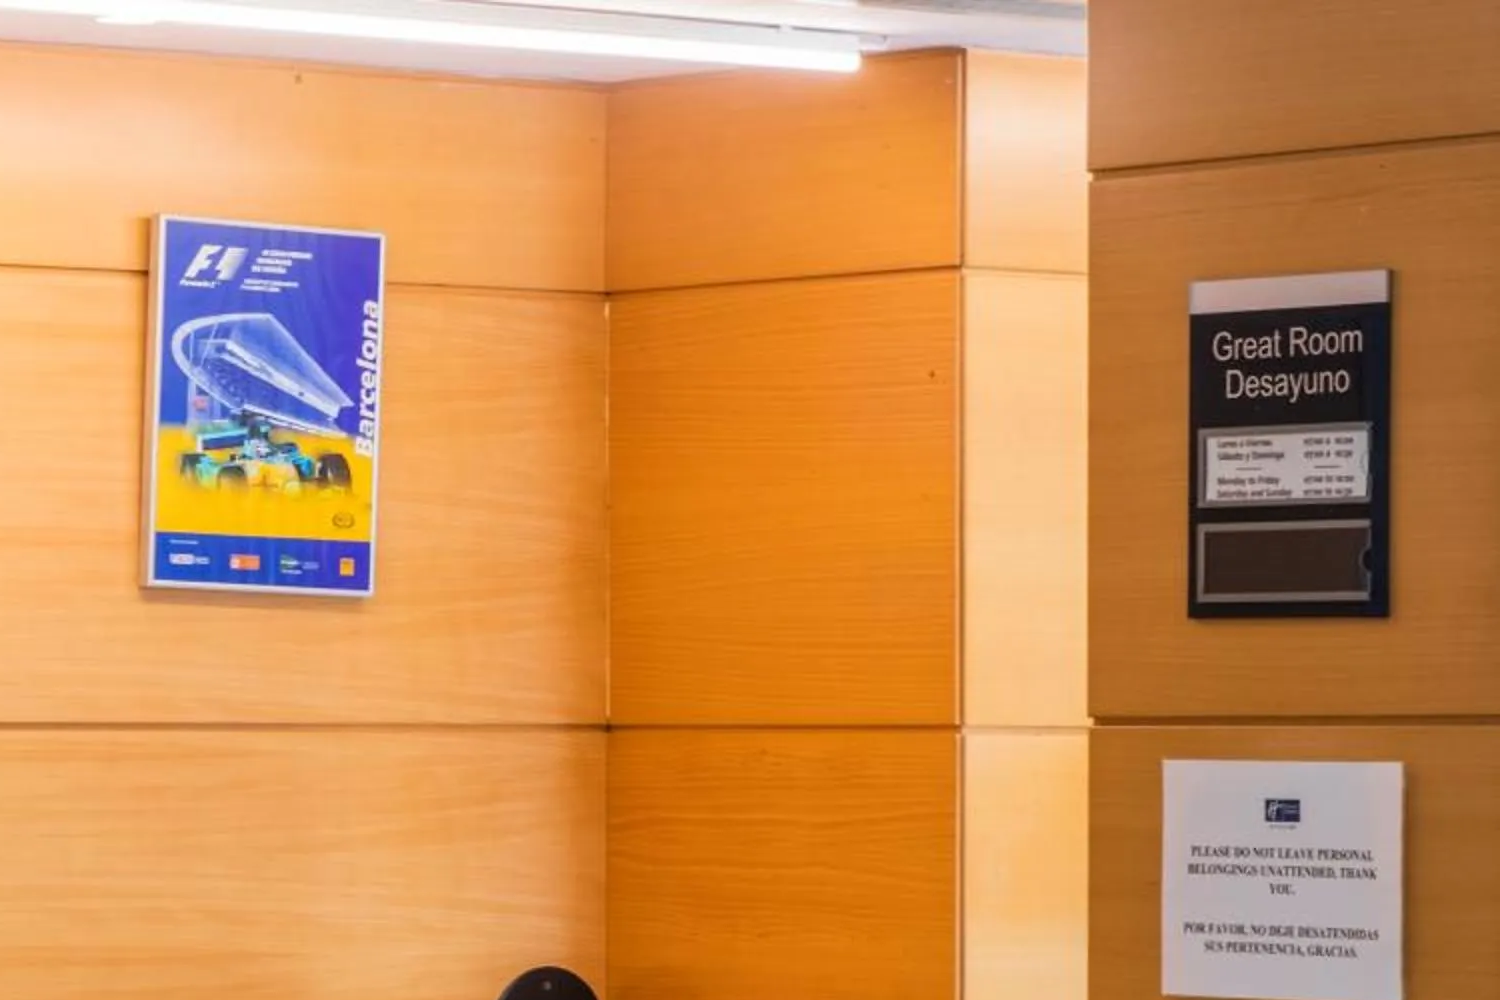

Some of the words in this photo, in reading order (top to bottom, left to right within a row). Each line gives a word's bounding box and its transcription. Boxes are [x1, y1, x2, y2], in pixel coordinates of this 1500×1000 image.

[1212, 329, 1282, 362] Great
[1289, 326, 1363, 357] Room
[355, 299, 379, 457] Barcelona
[1226, 368, 1350, 403] Desayuno
[1190, 845, 1230, 858] PLEASE
[1234, 846, 1251, 858] DO
[1253, 847, 1275, 859] NOT
[1277, 847, 1314, 860] LEAVE
[1317, 848, 1375, 862] PERSONAL
[1187, 863, 1258, 876] BELONGINGS
[1339, 867, 1377, 880] THANK
[1269, 883, 1296, 895] YOU.
[1183, 922, 1208, 934] POR
[1250, 924, 1267, 936] NO
[1297, 926, 1379, 940] DESATENDIDAS
